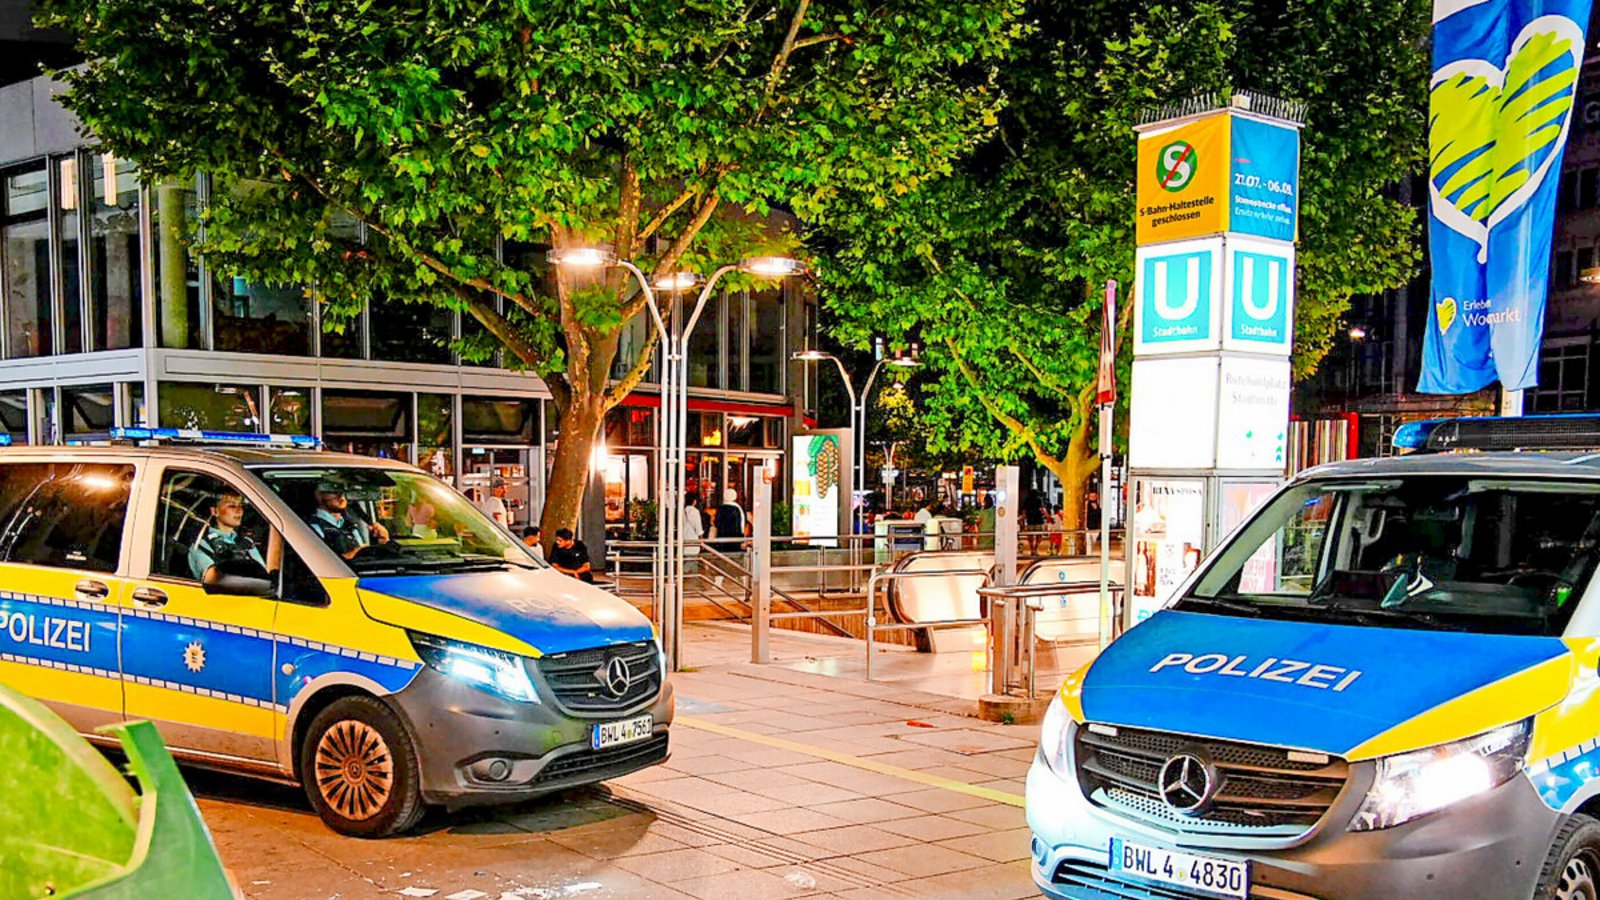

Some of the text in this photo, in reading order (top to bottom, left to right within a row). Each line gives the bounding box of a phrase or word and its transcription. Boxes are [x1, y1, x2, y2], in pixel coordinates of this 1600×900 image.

[1140, 196, 1214, 216] S-Bahn-Haltestelle
[1152, 210, 1200, 227] geschlossen
[1154, 256, 1200, 320] U
[1242, 256, 1280, 320] U
[1153, 326, 1198, 337] Stadtbahn
[1241, 324, 1277, 337] Stadtbahn
[1150, 653, 1362, 692] POLIZEI
[1123, 845, 1241, 891] BWL 4 4830
